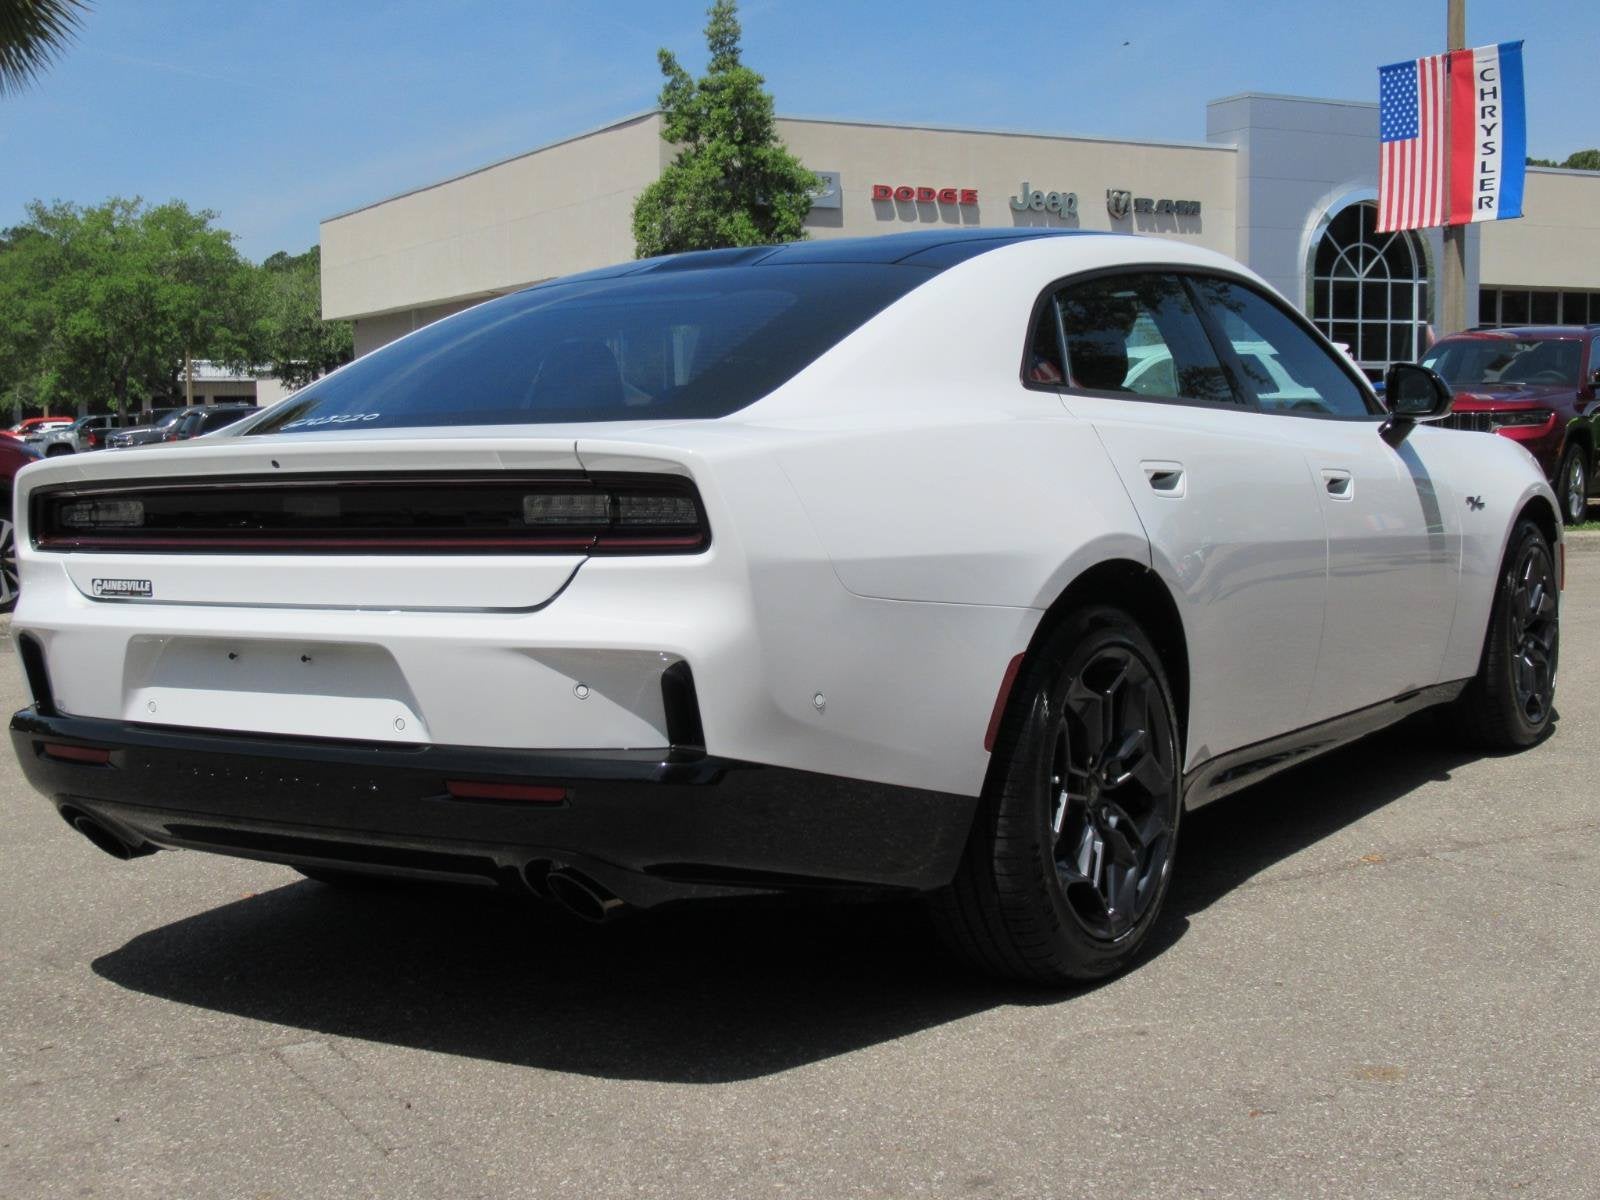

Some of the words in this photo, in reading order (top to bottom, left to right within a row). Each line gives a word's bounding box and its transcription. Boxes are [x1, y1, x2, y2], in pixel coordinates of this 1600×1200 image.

[1478, 67, 1497, 210] CHRYSLER
[872, 184, 978, 204] DODGE
[1010, 182, 1079, 218] Jeep
[1134, 198, 1200, 215] RAM
[93, 579, 151, 596] GAINESVILLE
